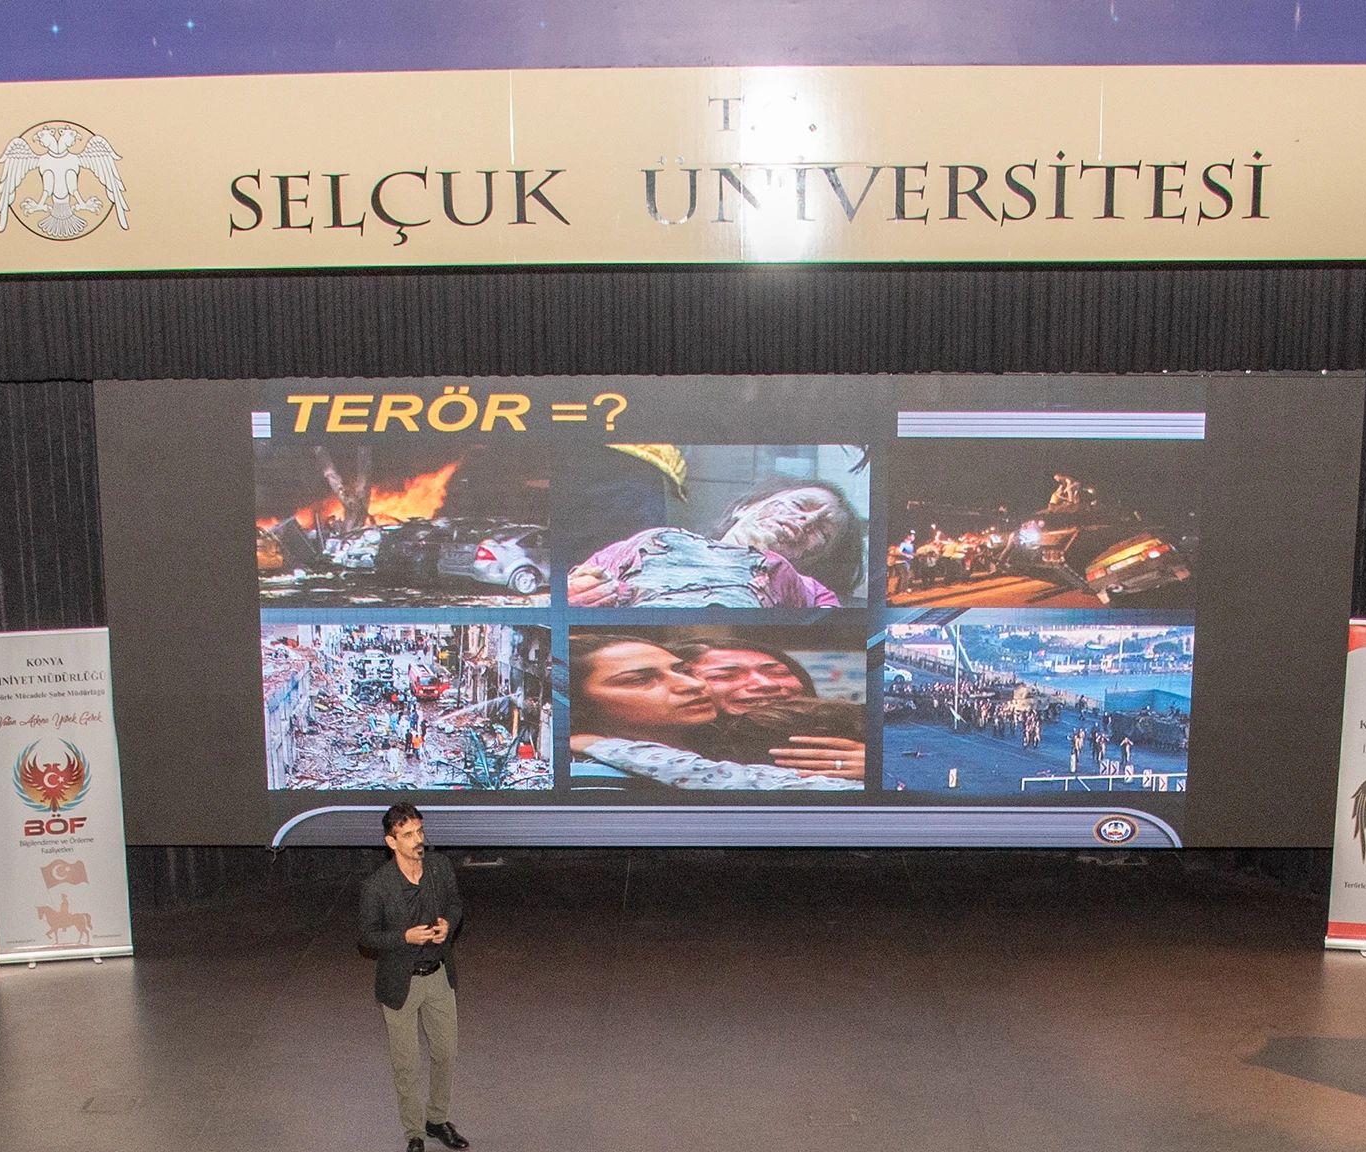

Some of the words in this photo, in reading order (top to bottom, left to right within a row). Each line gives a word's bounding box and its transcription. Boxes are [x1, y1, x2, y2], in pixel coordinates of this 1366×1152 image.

[229, 165, 571, 247] SELÇUK
[639, 149, 1273, 226] ÜNİVERSİTESİ
[286, 386, 532, 433] TERÖR
[26, 657, 64, 667] KONYA
[37, 670, 107, 684] MÜDÜRLÜĞÜ
[23, 813, 88, 837] BÖF
